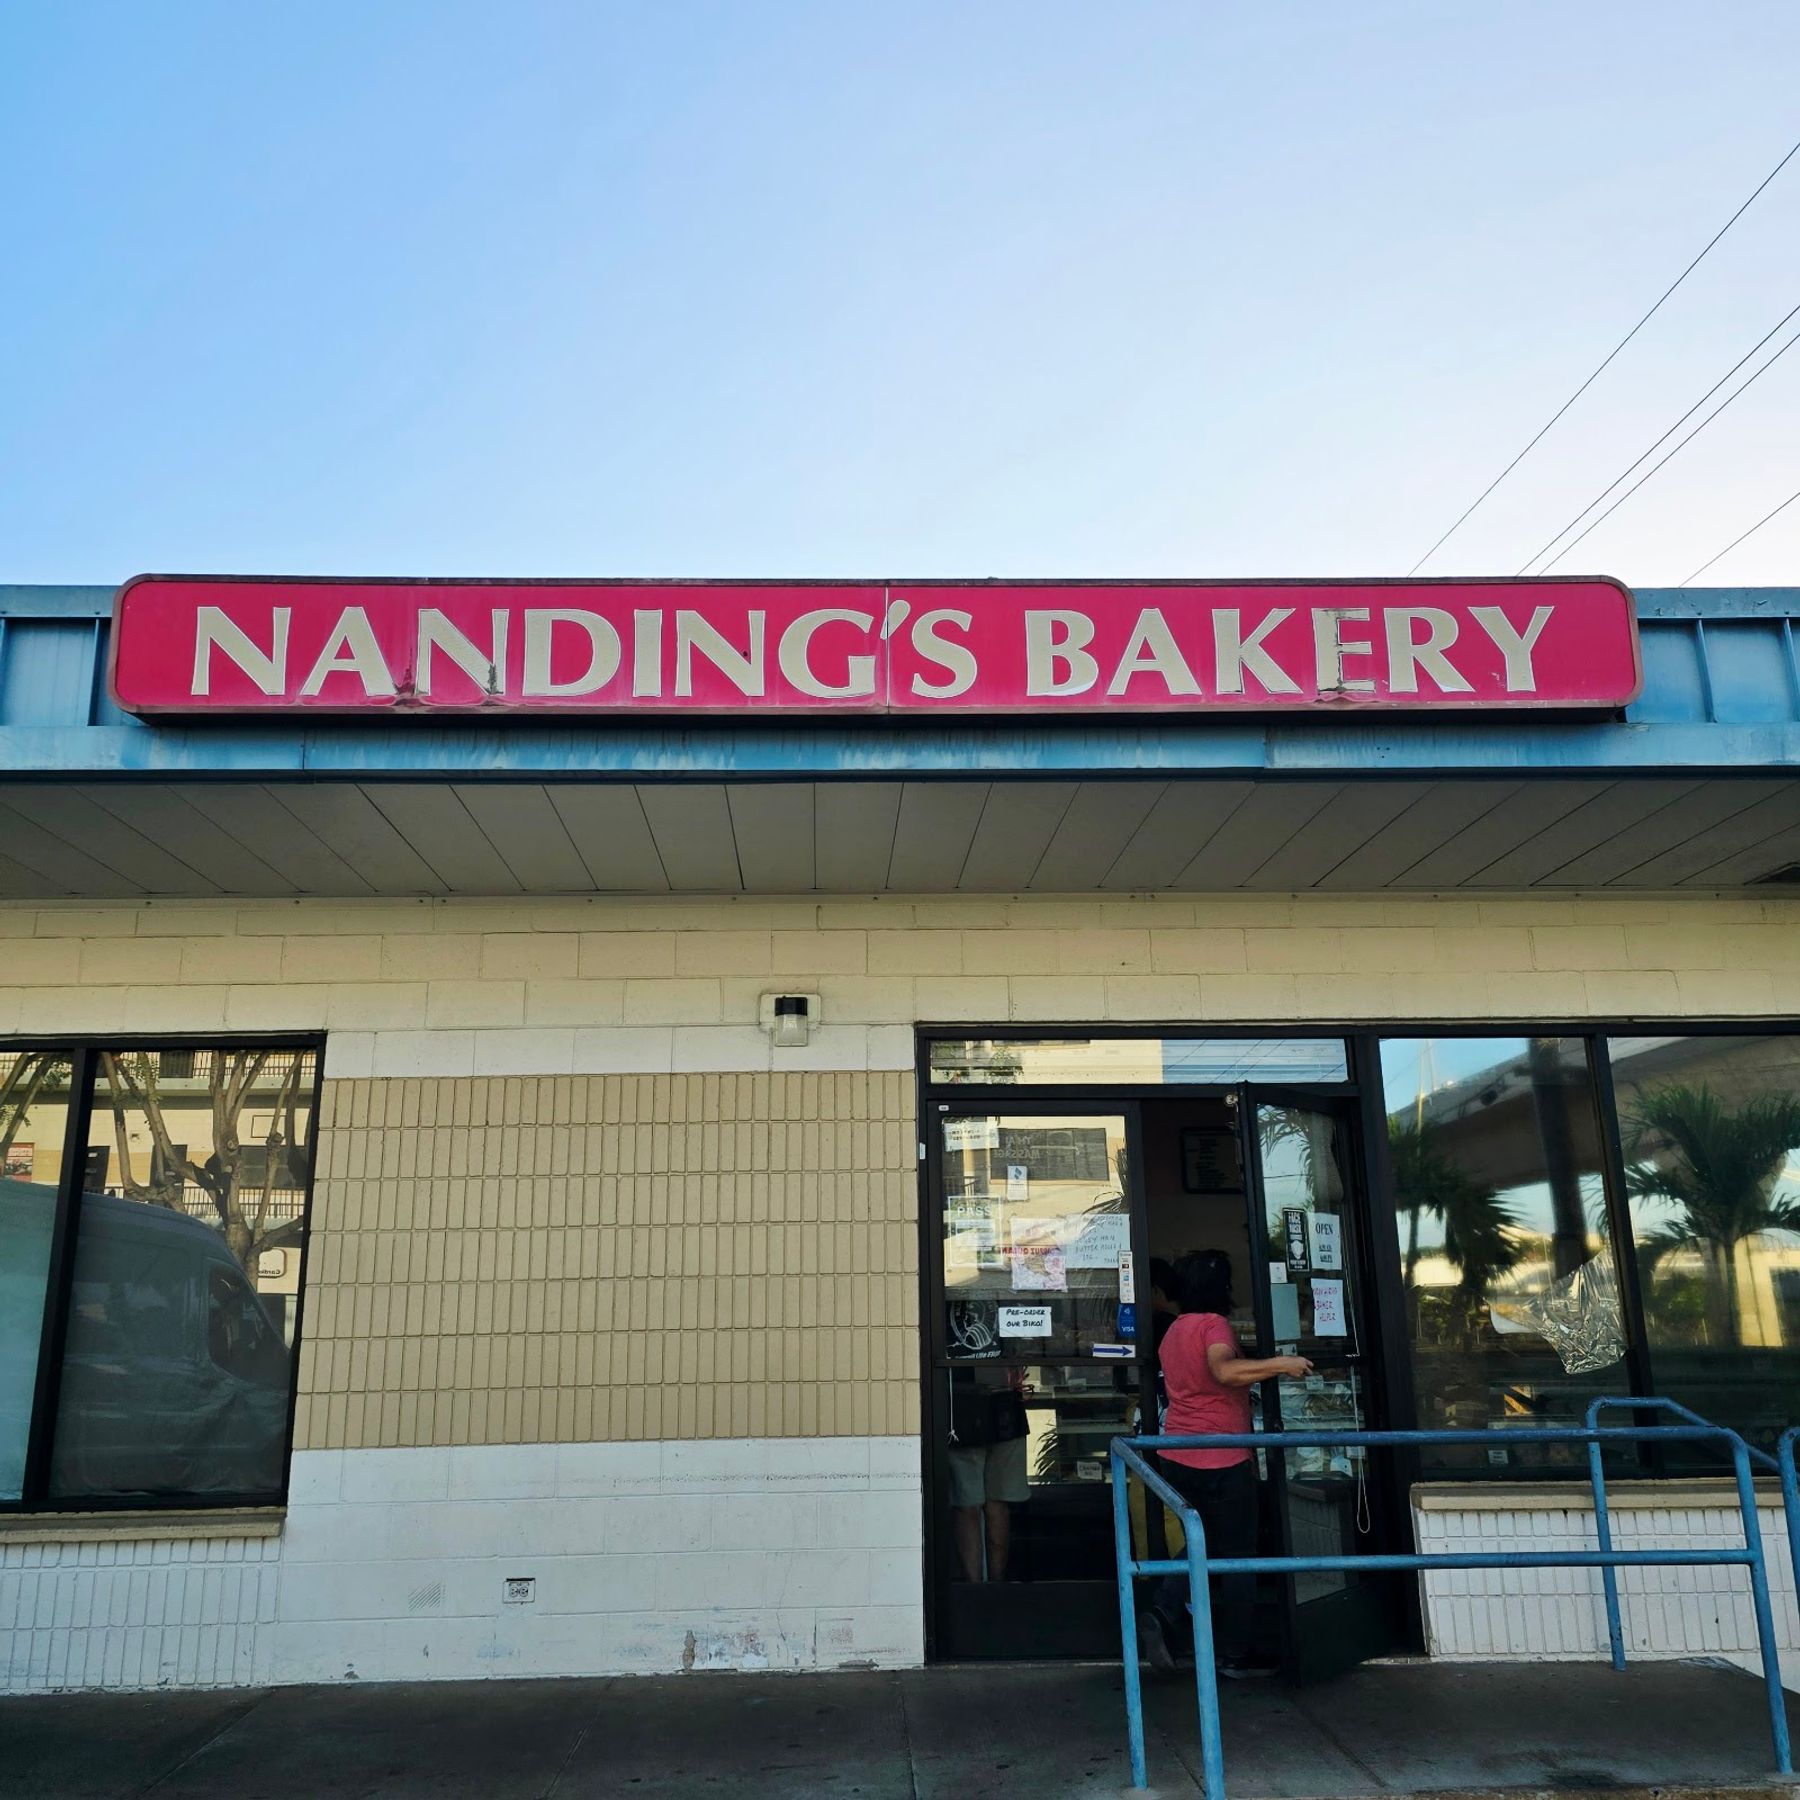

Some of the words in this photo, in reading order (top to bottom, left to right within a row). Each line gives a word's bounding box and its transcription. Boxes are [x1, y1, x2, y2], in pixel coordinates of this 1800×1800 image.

[191, 600, 978, 699] NANDING'S
[1024, 605, 1556, 697] BAKERY
[957, 1205, 992, 1217] PASS
[1315, 1222, 1334, 1236] OPEN
[1006, 1308, 1045, 1316] PRE-ORDER
[1006, 1320, 1021, 1328] OUR
[1022, 1319, 1043, 1328] BIKO!
[1121, 1325, 1136, 1333] VISA
